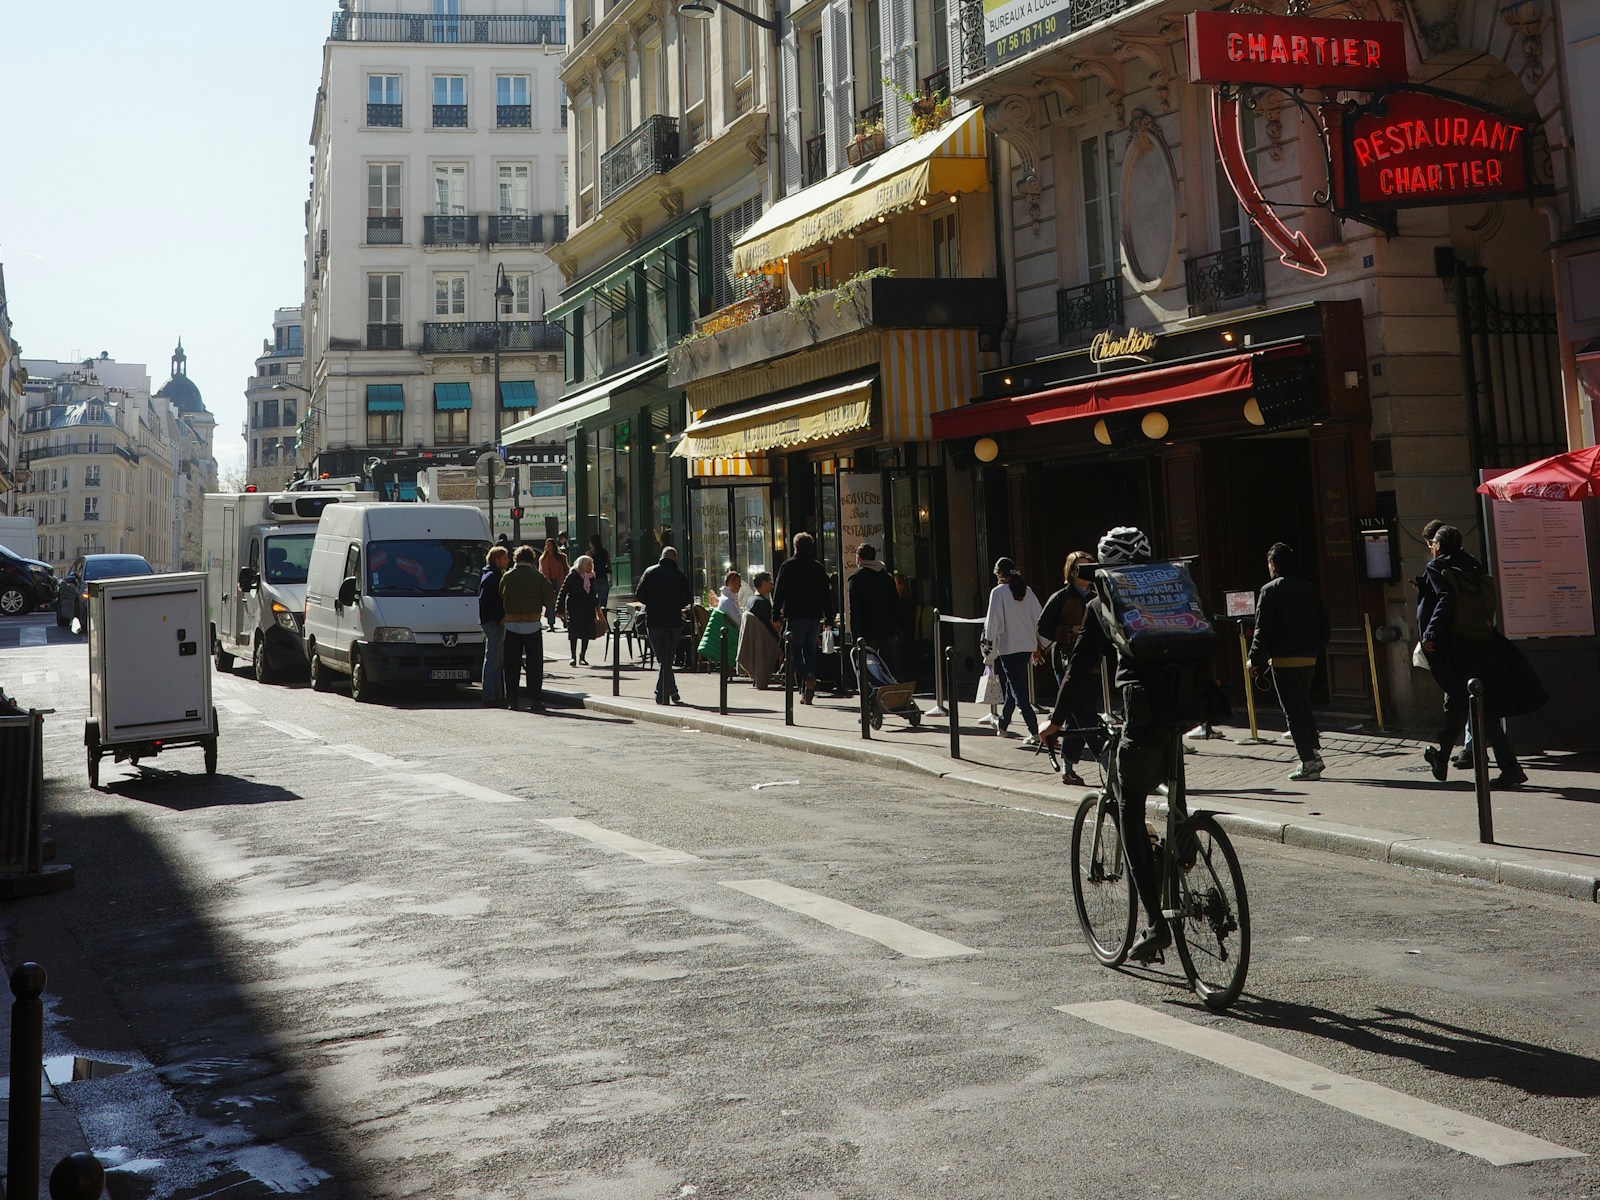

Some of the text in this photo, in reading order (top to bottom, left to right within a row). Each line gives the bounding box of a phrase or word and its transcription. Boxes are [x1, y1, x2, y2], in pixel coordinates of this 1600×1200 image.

[990, 4, 1026, 33] BUREAUX
[996, 16, 1056, 57] 07 56 78 71 90
[1226, 32, 1381, 69] CHARTIER
[1353, 117, 1524, 167] RESTAURANT
[1379, 158, 1503, 195] CHARTIER
[841, 491, 881, 505] BRASSERIE
[1360, 517, 1387, 526] MENU
